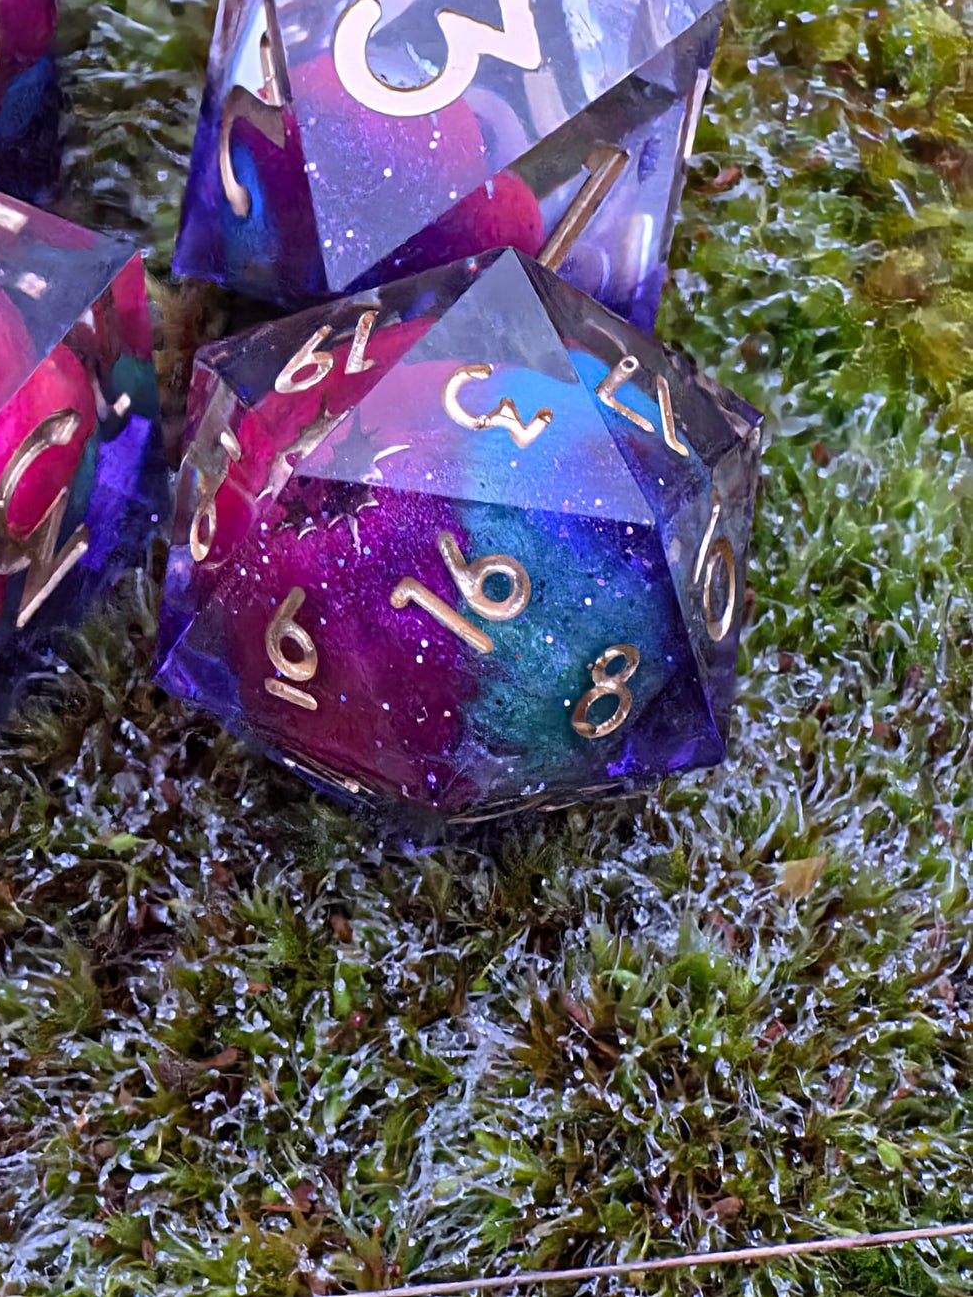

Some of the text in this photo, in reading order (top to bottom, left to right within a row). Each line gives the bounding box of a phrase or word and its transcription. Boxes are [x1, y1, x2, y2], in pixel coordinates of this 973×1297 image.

[440, 363, 554, 449] 3
[389, 530, 532, 654] 16
[570, 643, 640, 739] 8
